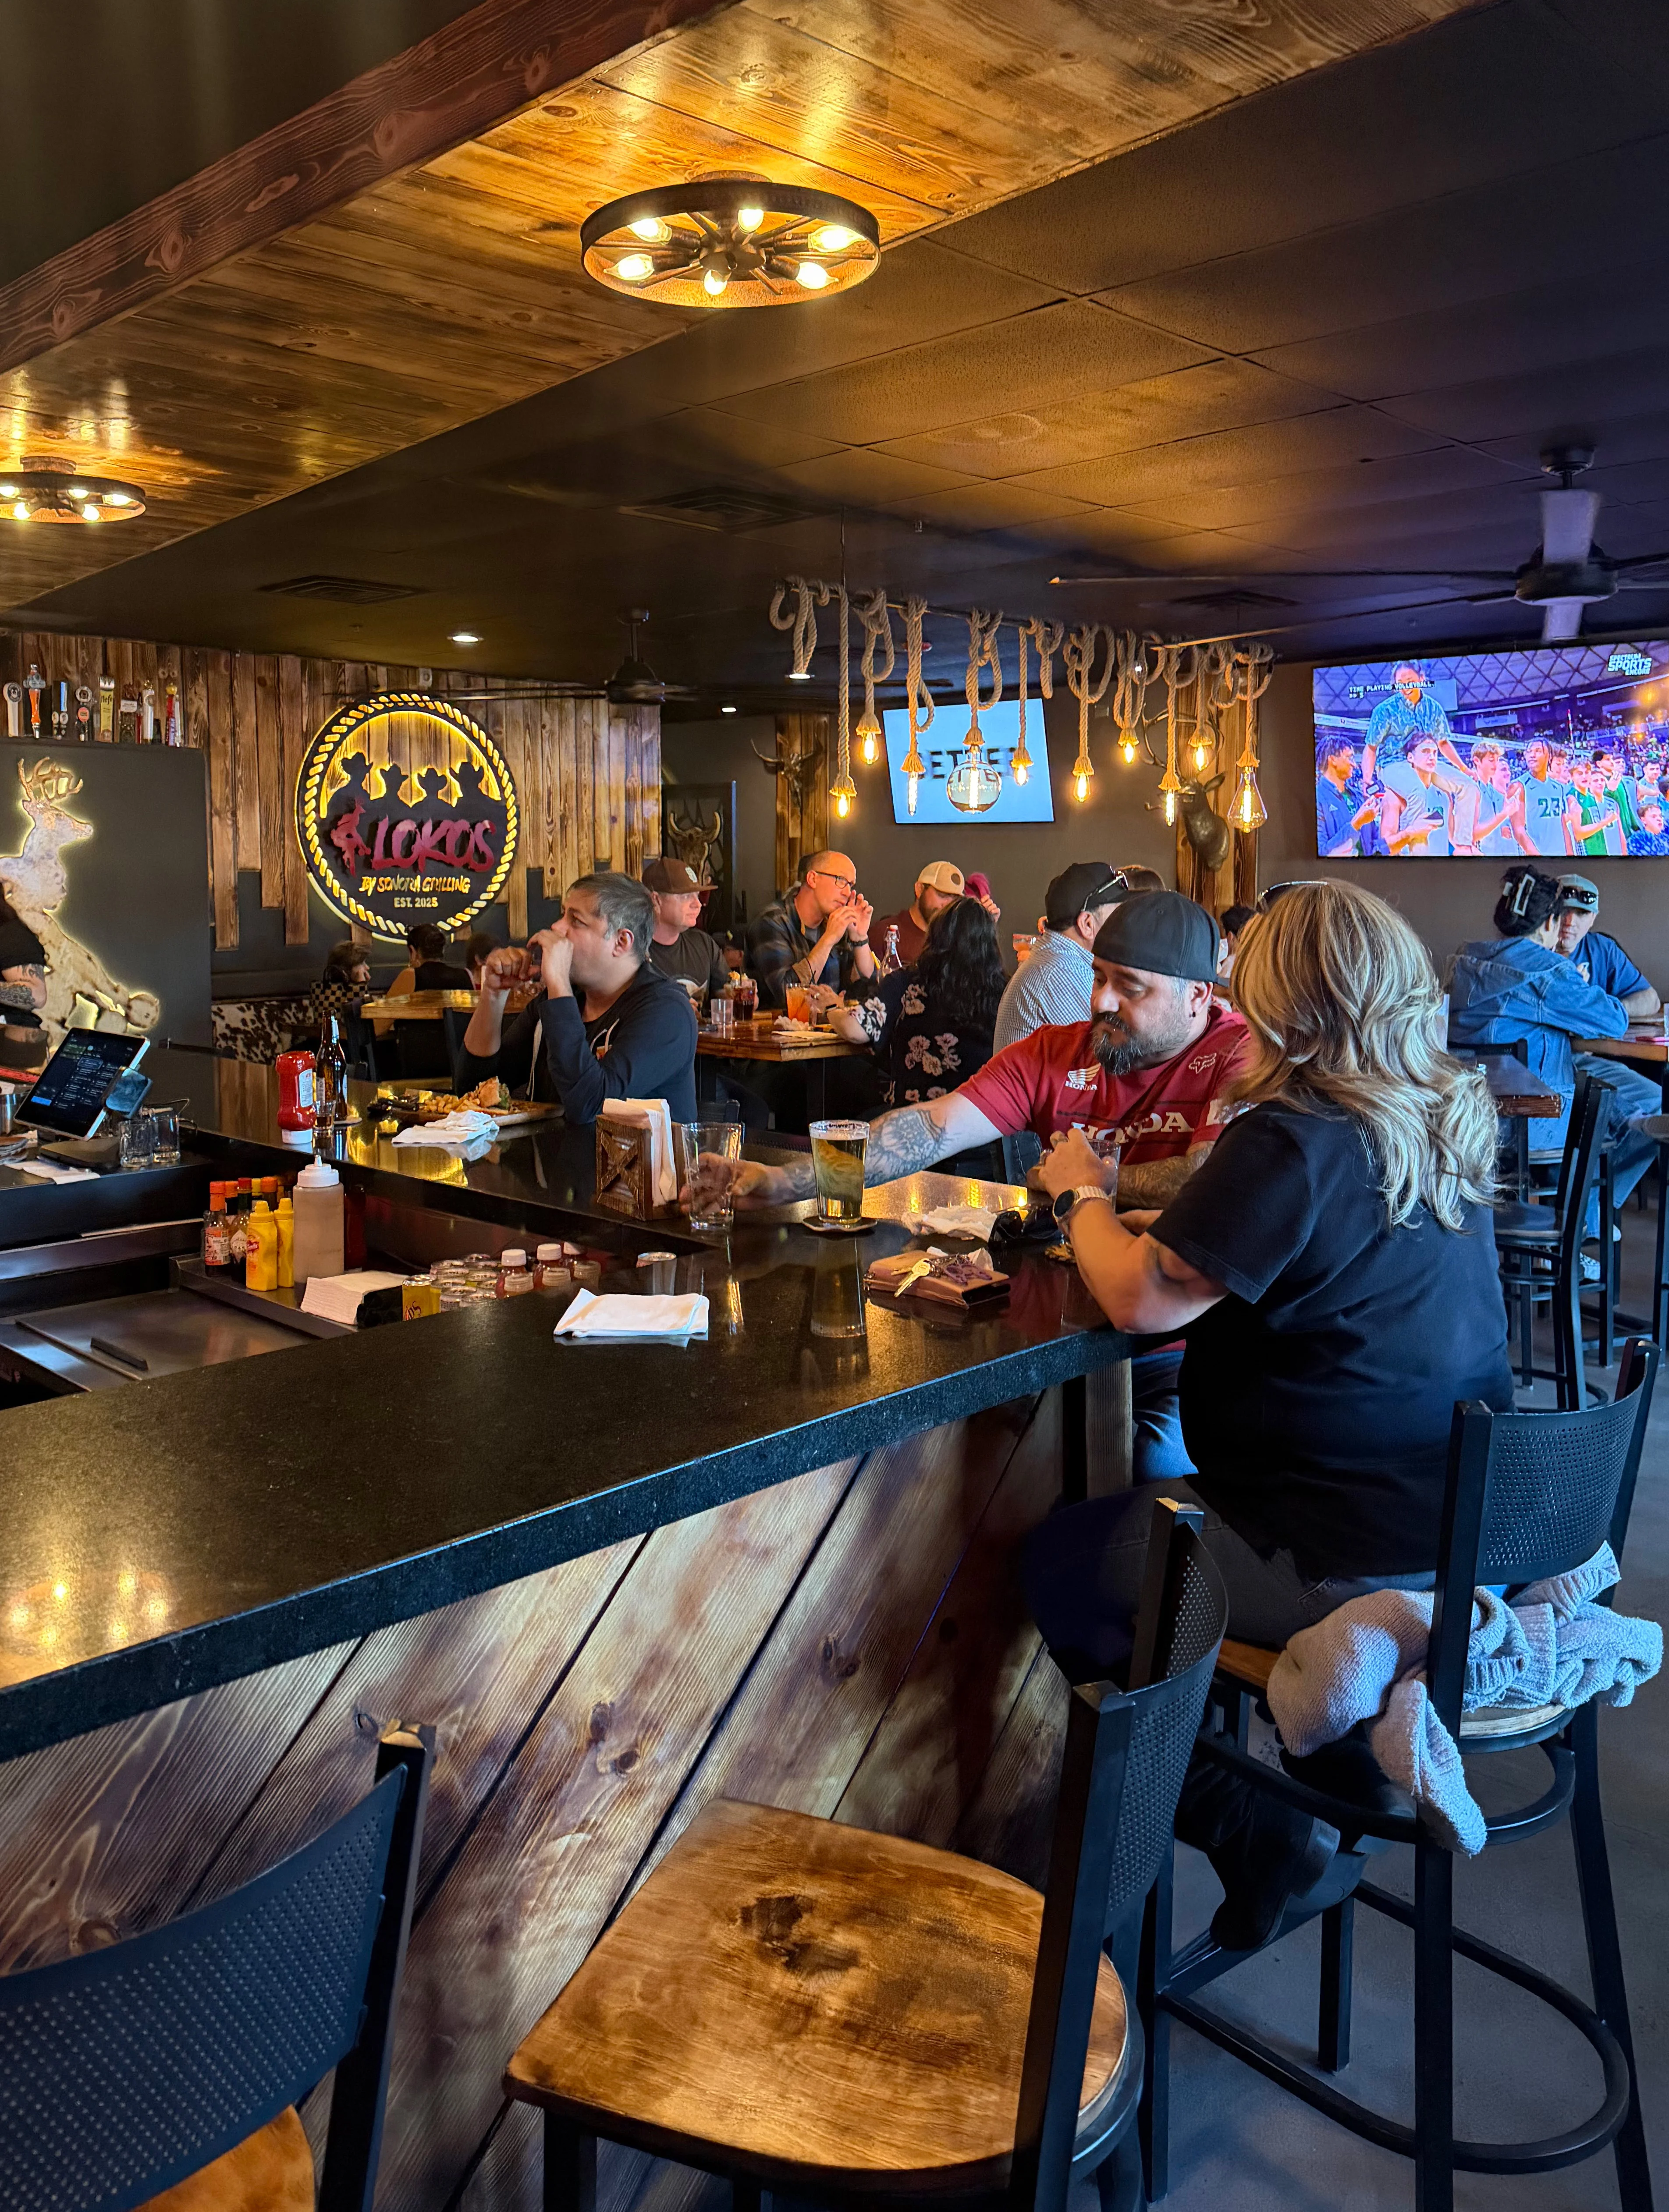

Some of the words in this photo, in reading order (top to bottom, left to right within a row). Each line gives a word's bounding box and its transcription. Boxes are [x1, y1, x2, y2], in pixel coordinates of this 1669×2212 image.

[1608, 657, 1652, 671] SPORTS
[1366, 684, 1392, 692] PLAYING
[1538, 797, 1560, 818] 23
[371, 814, 496, 873] LOKOS
[359, 876, 377, 897] BY
[377, 873, 421, 893] SONORA
[422, 875, 471, 894] GRILLING
[394, 897, 412, 908] EST.
[414, 897, 438, 908] 2025
[1065, 1081, 1098, 1091] HONDA
